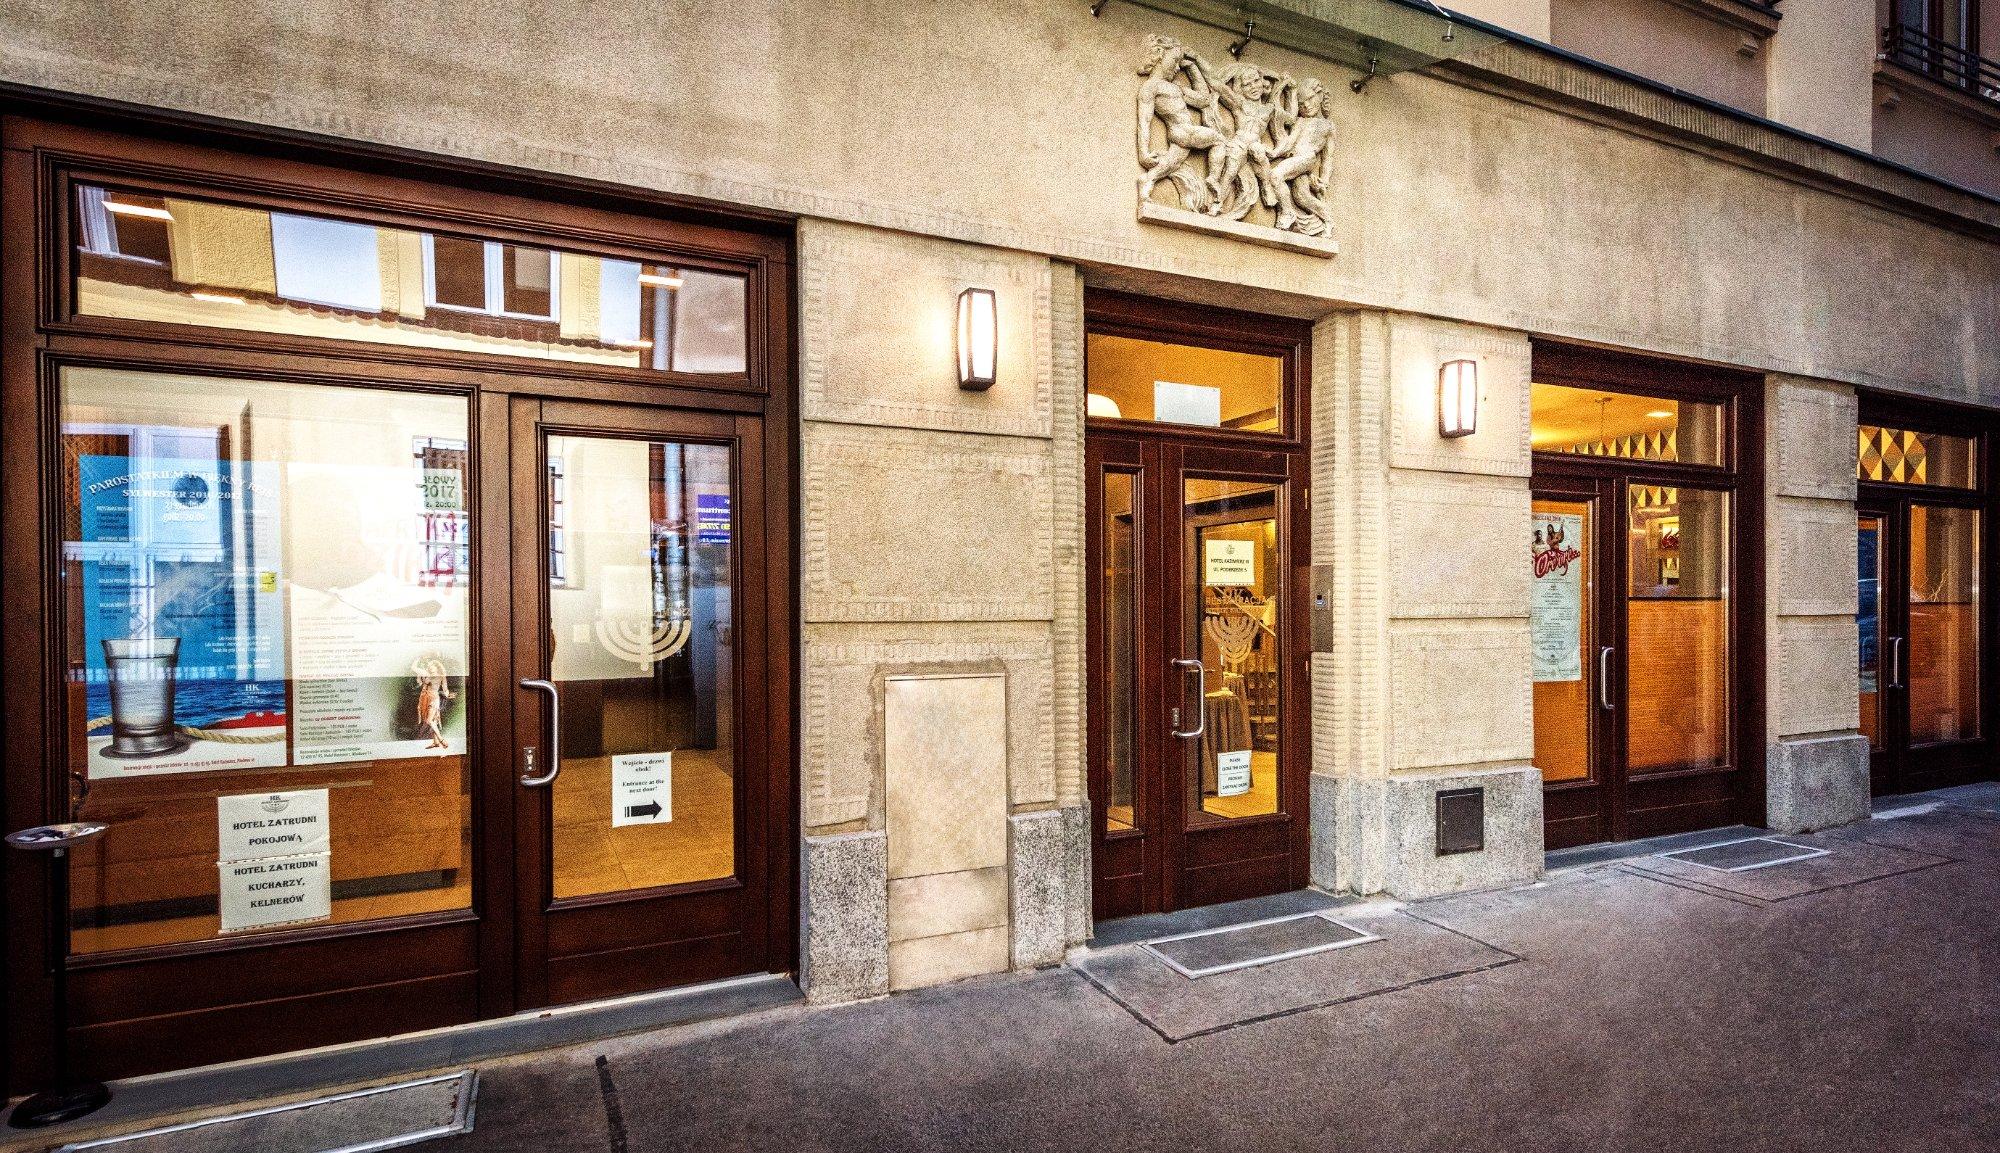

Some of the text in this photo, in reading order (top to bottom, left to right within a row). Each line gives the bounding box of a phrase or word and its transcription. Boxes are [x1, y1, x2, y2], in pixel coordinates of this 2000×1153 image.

[422, 485, 455, 499] 2017
[233, 815, 317, 831] HOTEL ZATRUDNI
[248, 833, 303, 846] POKOJOWĄ
[234, 860, 318, 876] HOTEL ZATRUDNI
[248, 877, 306, 892] KUCHARZY,
[250, 893, 305, 909] KELNERÓW
